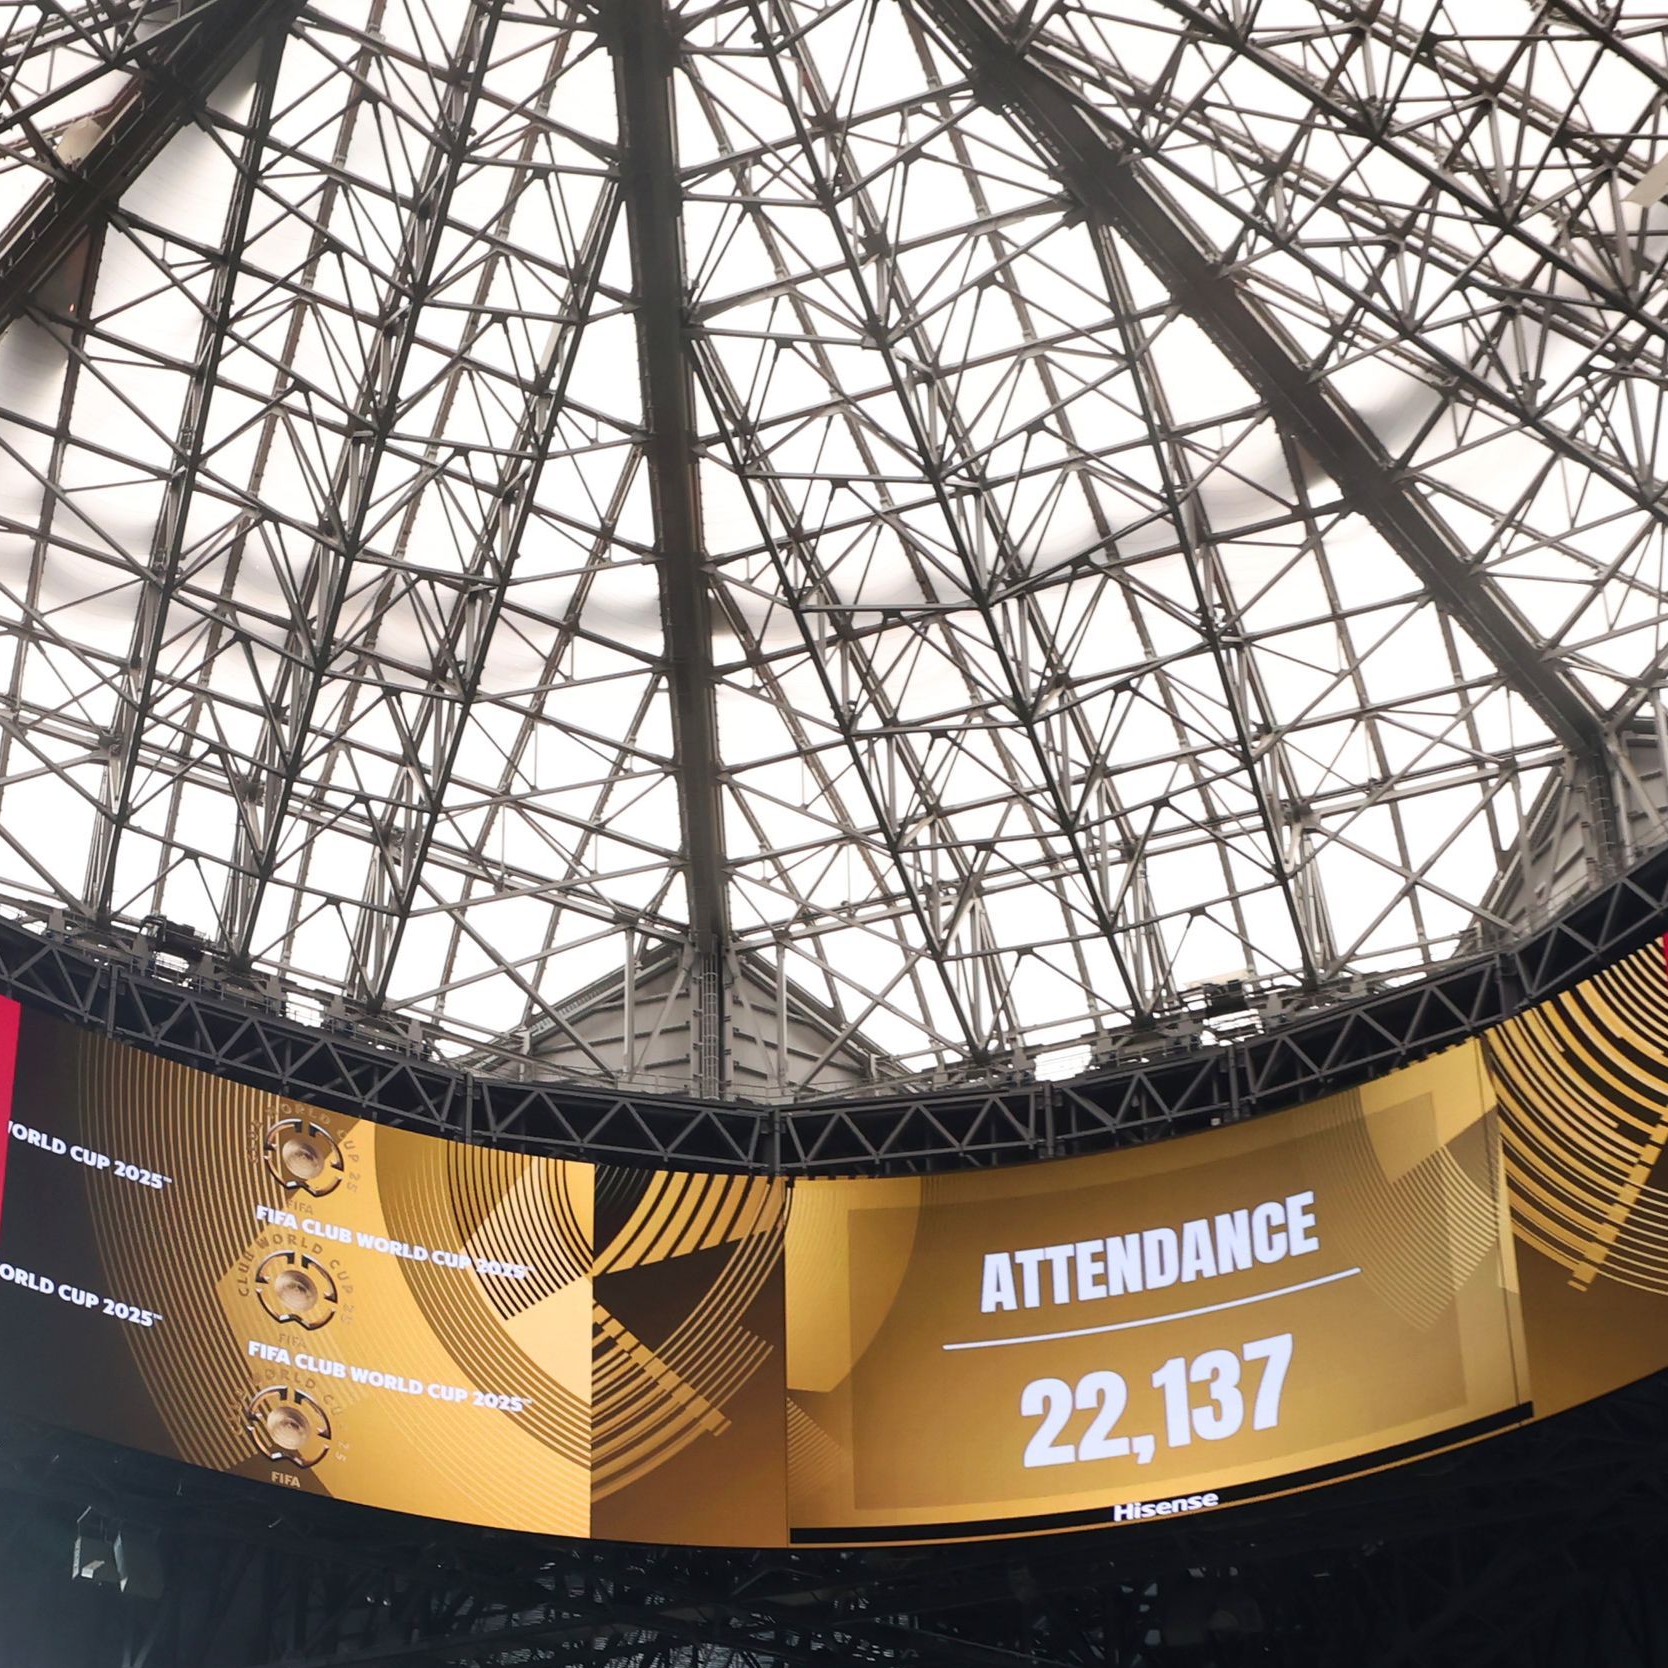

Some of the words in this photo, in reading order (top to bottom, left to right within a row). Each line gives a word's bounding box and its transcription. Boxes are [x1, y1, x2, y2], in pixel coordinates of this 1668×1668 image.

[70, 1144, 111, 1172] CUP
[255, 1205, 297, 1231] FIFA
[302, 1217, 353, 1244] CLUB
[356, 1231, 429, 1263] WORLD
[431, 1249, 471, 1270] CUP
[256, 1233, 323, 1255] WORLD
[981, 1190, 1320, 1313] ATTENDANCE
[58, 1282, 99, 1310] CUP
[248, 1340, 291, 1366] FIFA
[294, 1352, 347, 1378] CLUB
[350, 1365, 423, 1396] WORLD
[427, 1382, 468, 1404] CUP
[1019, 1332, 1294, 1469] 22,137
[271, 1470, 301, 1488] FIFA
[1113, 1492, 1220, 1522] Hisense
